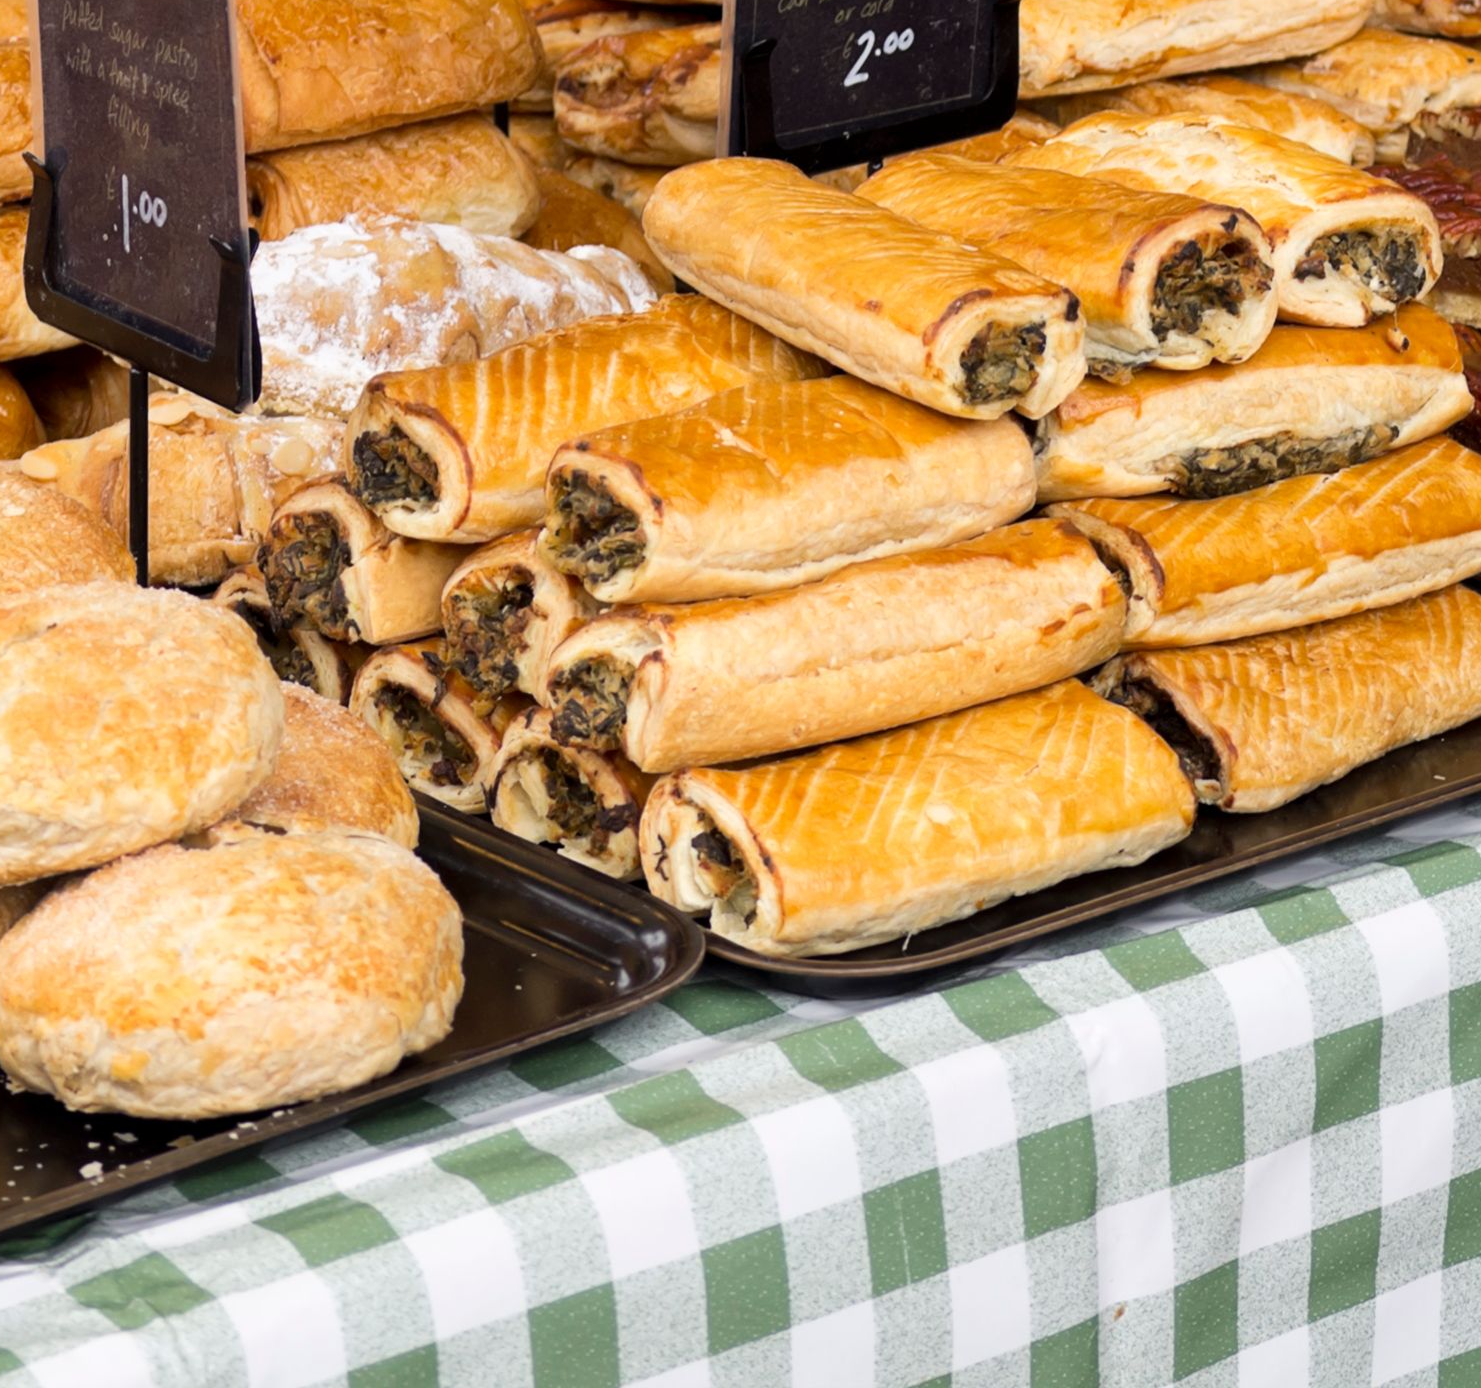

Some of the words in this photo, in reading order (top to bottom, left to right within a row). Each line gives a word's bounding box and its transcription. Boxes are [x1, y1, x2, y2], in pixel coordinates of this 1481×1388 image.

[834, 3, 857, 23] or
[66, 43, 93, 78] with
[97, 63, 105, 81] a
[109, 57, 139, 101] fruit
[153, 79, 191, 110] spice
[108, 93, 150, 151] filling
